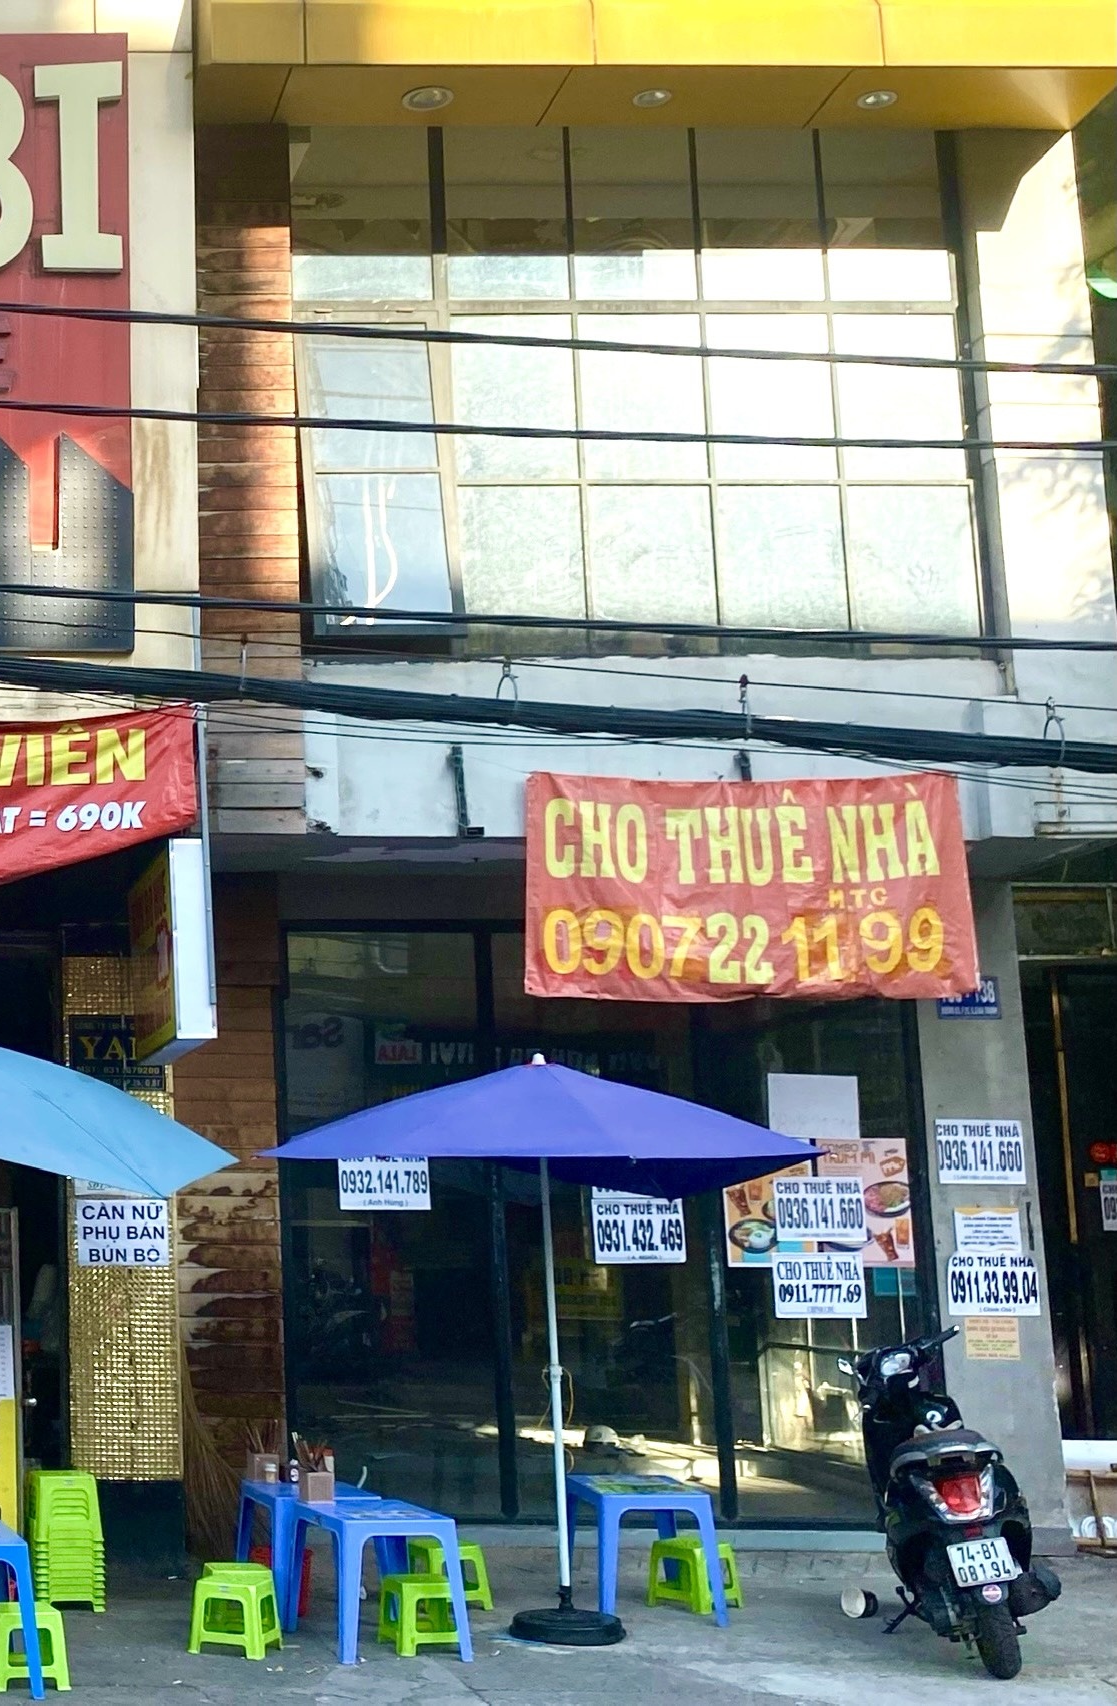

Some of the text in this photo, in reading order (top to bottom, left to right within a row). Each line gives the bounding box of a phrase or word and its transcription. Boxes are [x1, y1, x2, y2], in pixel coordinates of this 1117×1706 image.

[29, 813, 47, 828] =
[56, 800, 146, 832] 690K
[543, 783, 941, 886] CHO THUÊ NHÀ
[935, 1122, 1020, 1137] CHO THUÊ NHÀ
[938, 1139, 1023, 1172] 0936.141.660
[341, 1169, 428, 1194] 0932.141.789
[776, 1180, 861, 1194] CHO THUÊ NHÀ
[132, 1202, 163, 1220] NỮ
[597, 1204, 620, 1215] CHO
[624, 1200, 653, 1215] THUÊ
[778, 1198, 863, 1229] 0936.141.660
[82, 1221, 164, 1243] PHỤ BÁN
[89, 1244, 160, 1262] BÚN BÒ
[951, 1256, 974, 1267] CHO
[777, 1256, 861, 1281] CHO THUÊ NHÀ
[779, 1283, 862, 1303] 0911.7777.69
[951, 1270, 1038, 1304] 0911.33.99.04
[956, 1541, 999, 1563] 74-B1
